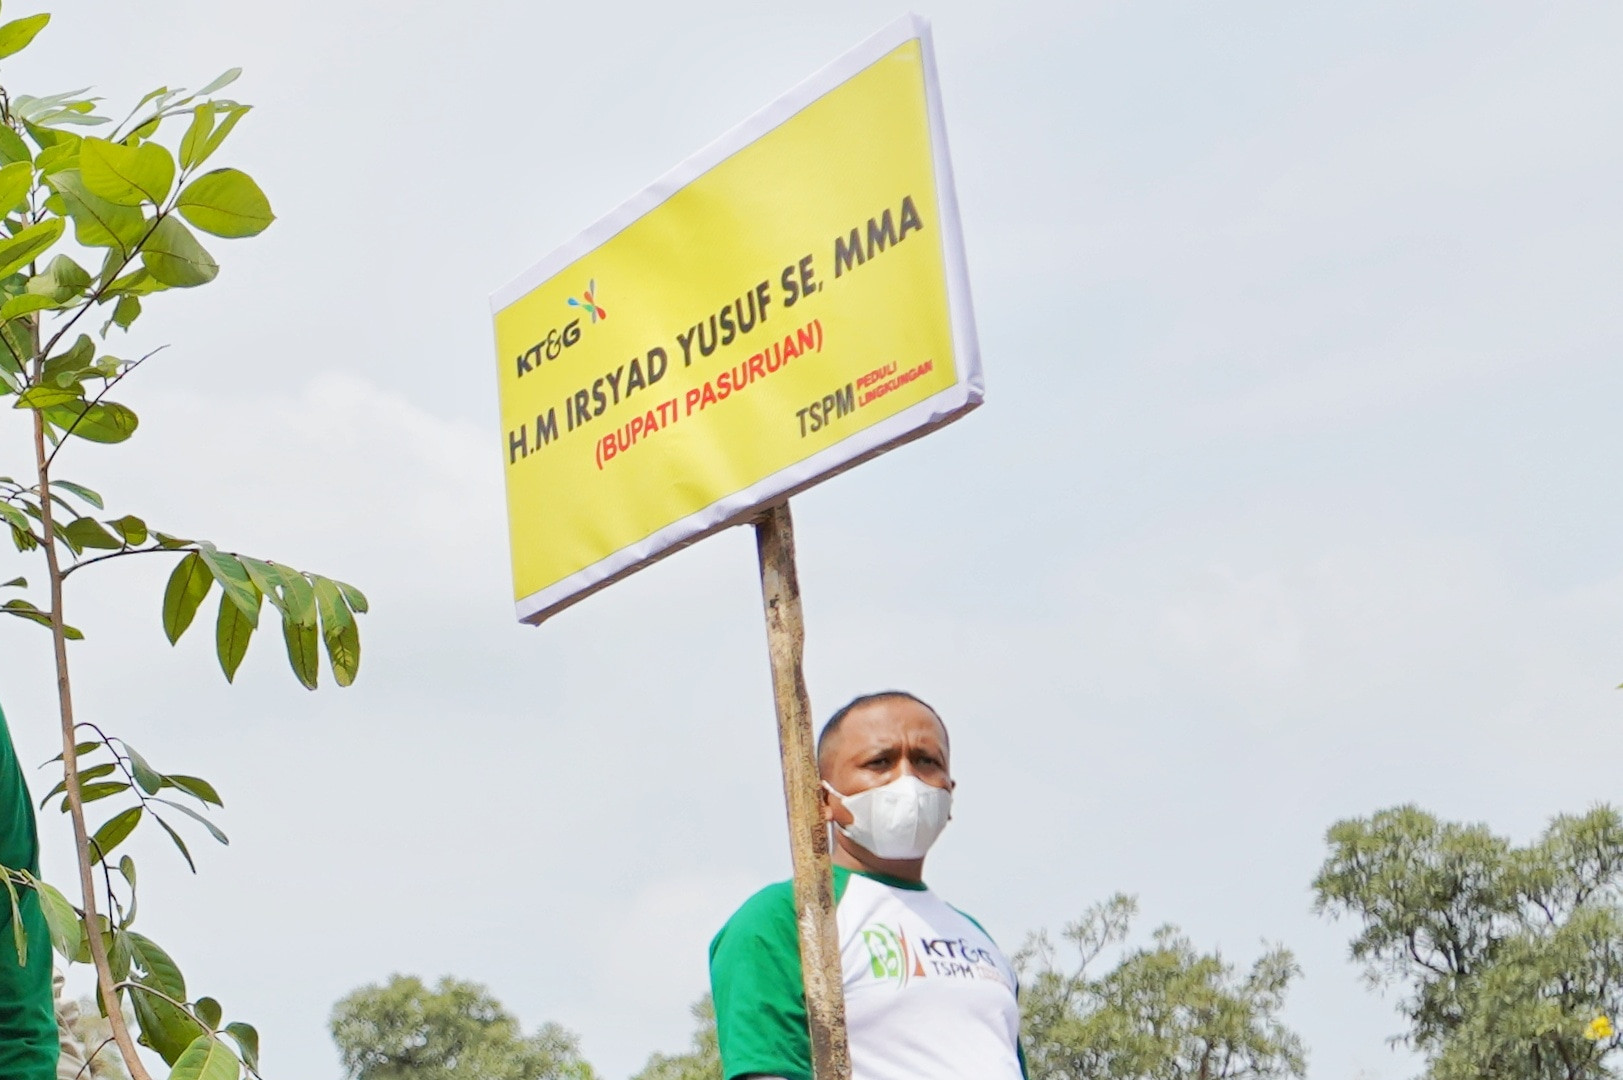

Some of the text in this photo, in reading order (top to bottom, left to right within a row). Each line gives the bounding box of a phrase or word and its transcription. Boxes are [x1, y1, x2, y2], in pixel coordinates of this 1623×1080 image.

[509, 195, 924, 465] H.M IRSYAD YUSUF SE, MMA
[516, 318, 581, 378] KT&G
[595, 318, 823, 470] (BUPATI PASURUAN)
[856, 360, 898, 390] PEDULI
[858, 359, 933, 408] LINGKUNGAN
[795, 382, 856, 438] TSPM
